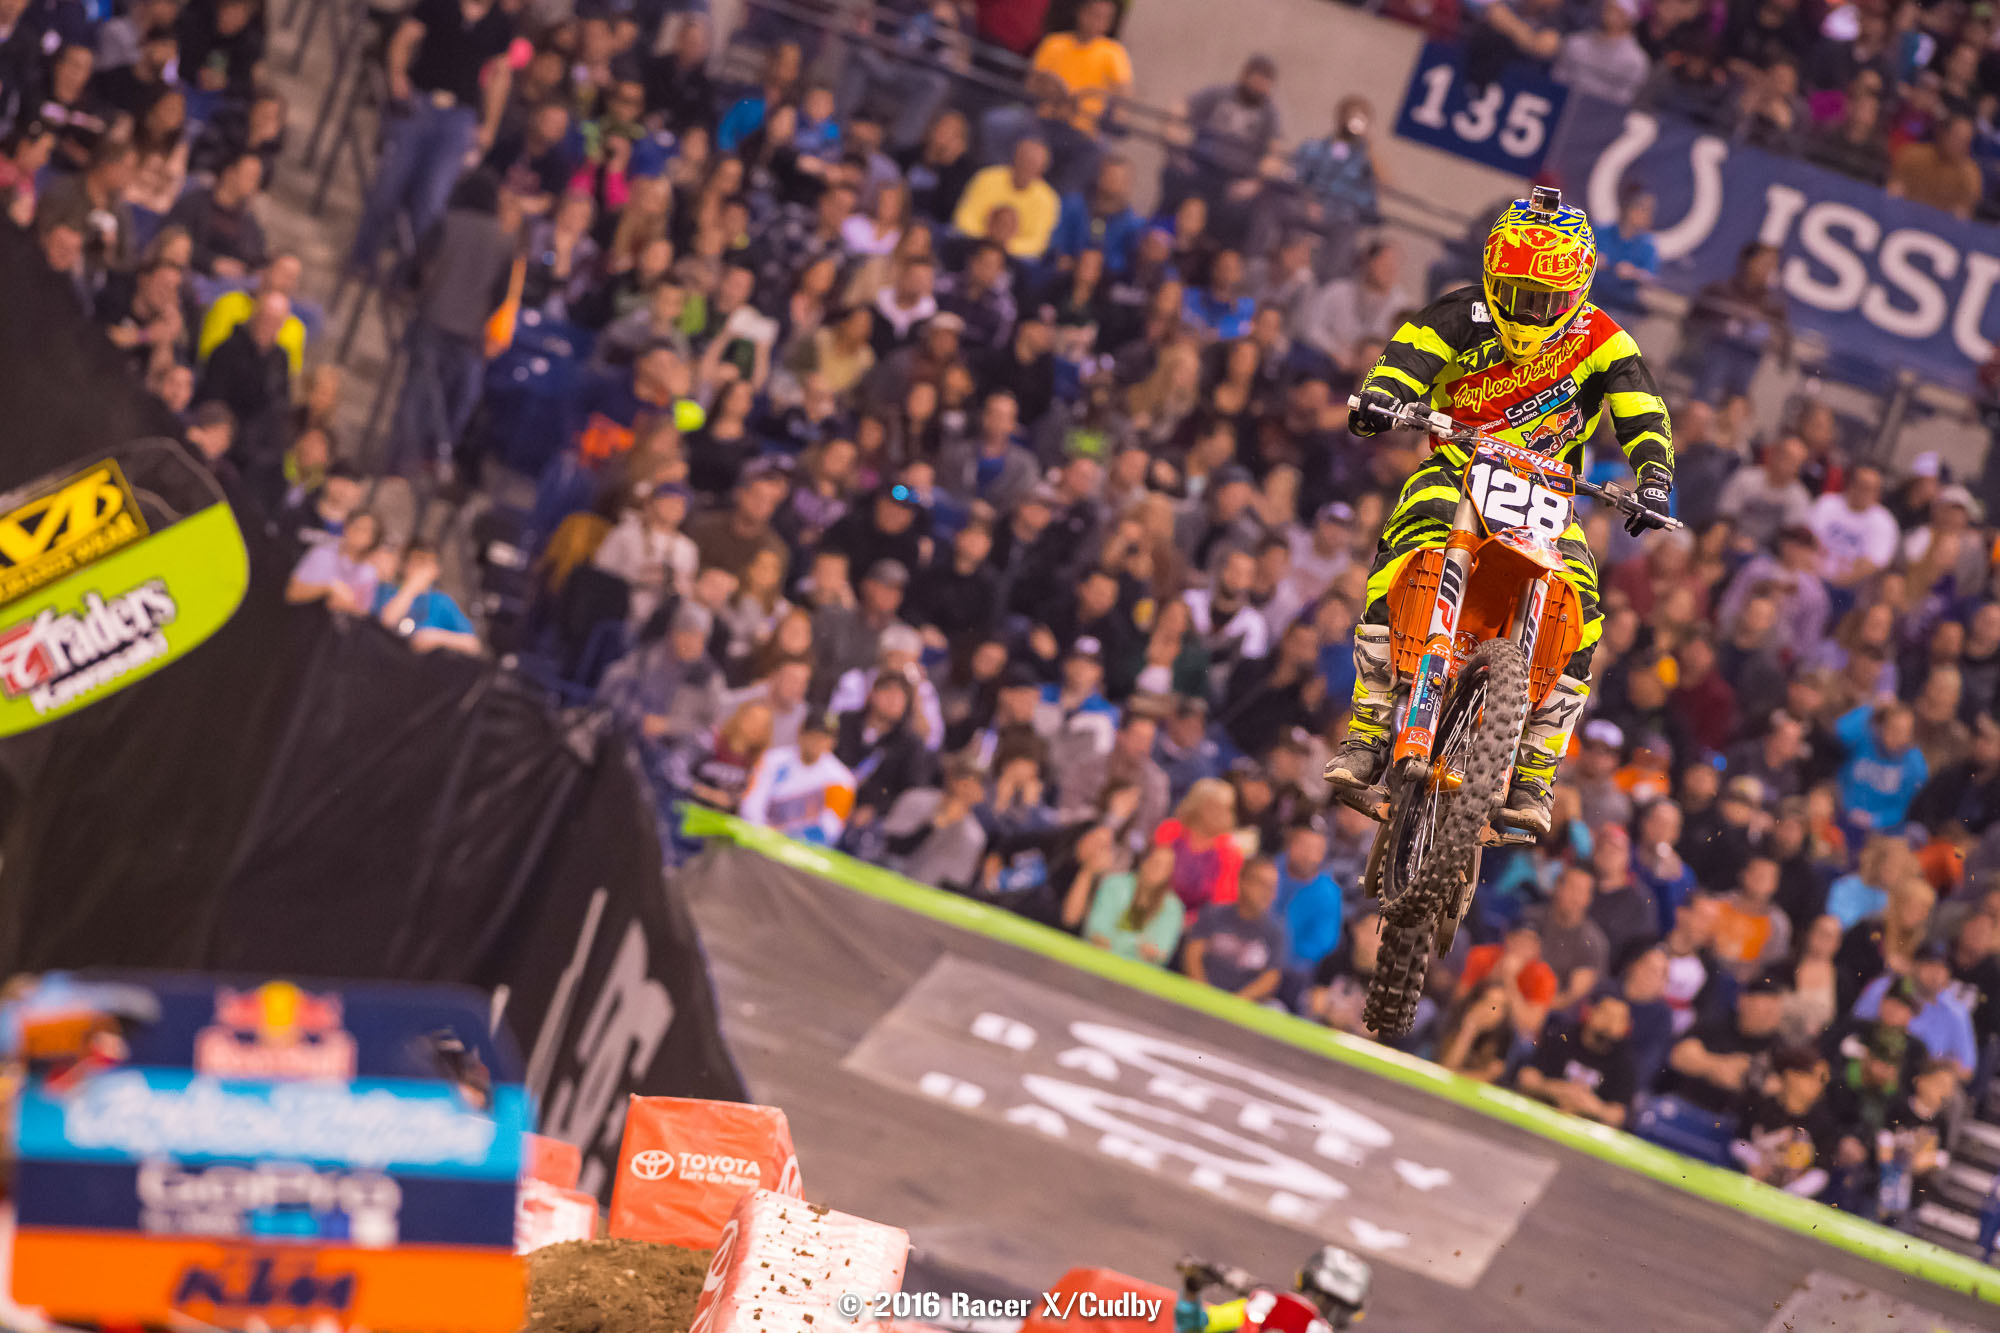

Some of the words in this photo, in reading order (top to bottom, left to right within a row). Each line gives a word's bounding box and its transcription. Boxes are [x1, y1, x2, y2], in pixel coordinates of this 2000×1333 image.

[1409, 64, 1553, 160] 135
[1454, 383, 1482, 413] Troy
[1483, 377, 1517, 400] Lee
[1512, 335, 1585, 387] Designs
[1505, 378, 1575, 420] GoPro
[1470, 462, 1569, 540] 128
[679, 1152, 761, 1177] TOYOTA
